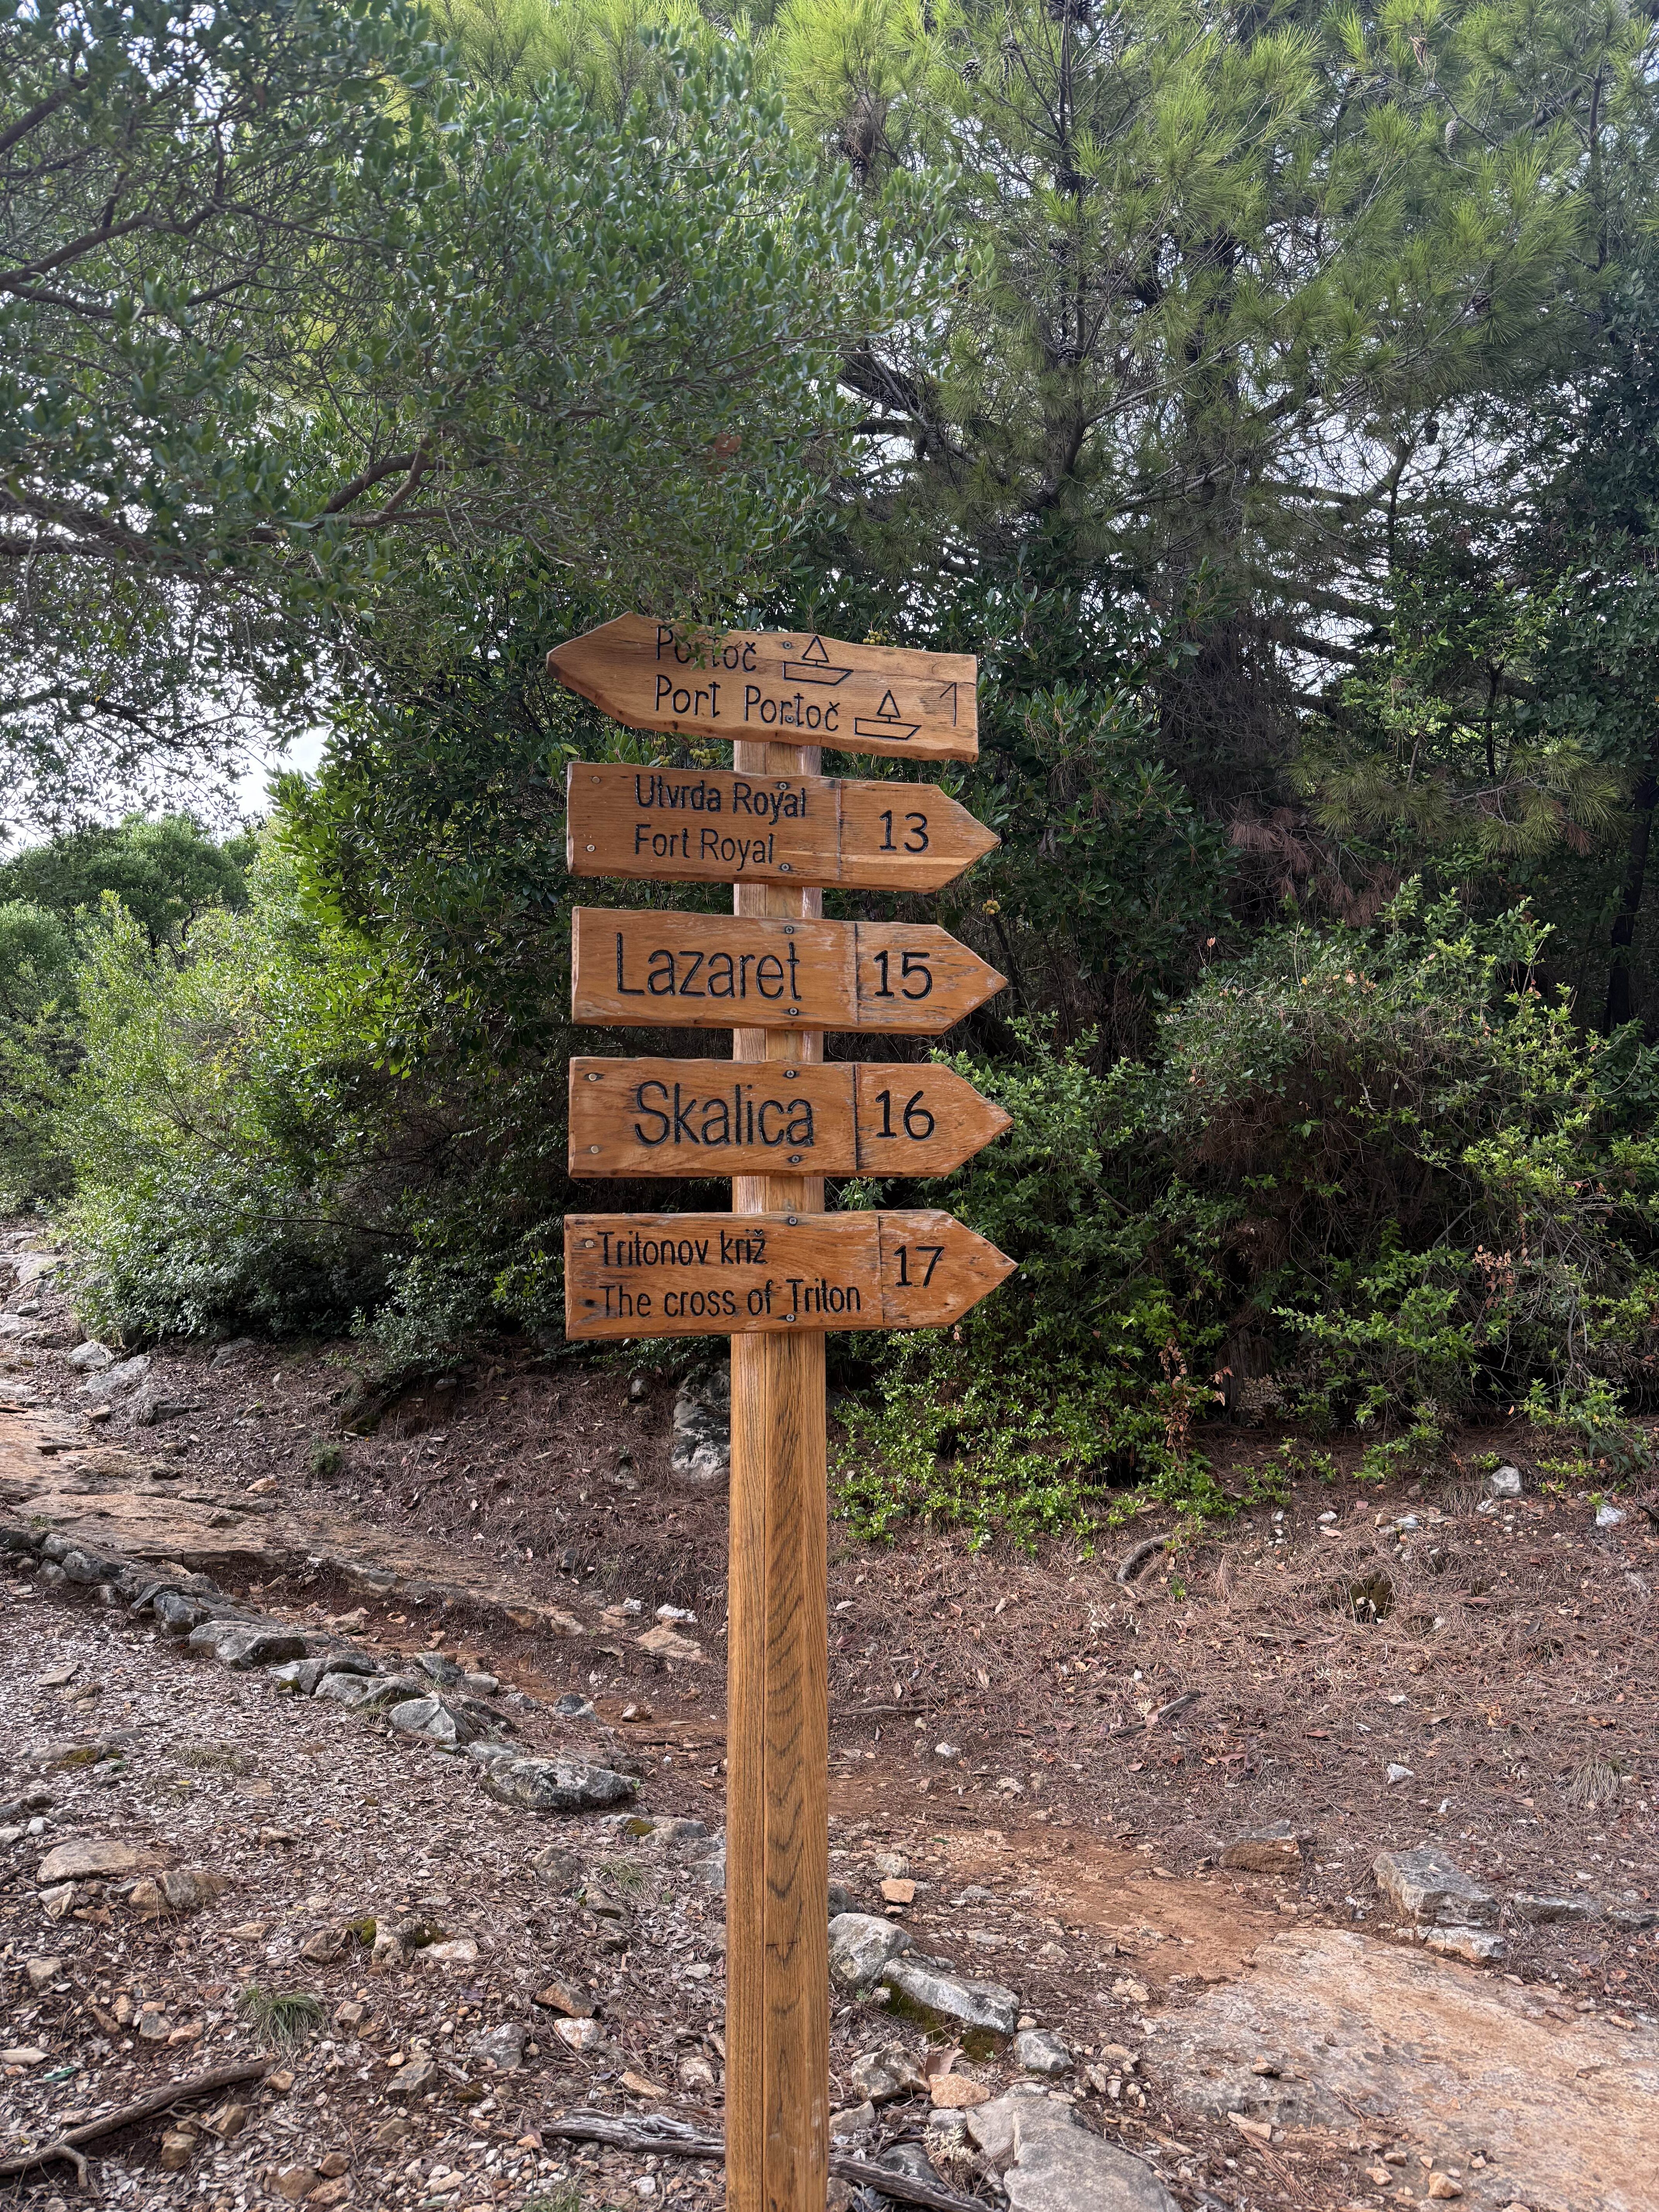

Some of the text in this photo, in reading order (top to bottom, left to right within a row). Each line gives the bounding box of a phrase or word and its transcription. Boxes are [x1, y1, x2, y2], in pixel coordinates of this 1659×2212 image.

[655, 624, 757, 673] Potoč
[654, 674, 841, 732] Port Portoč
[939, 682, 958, 727] 1
[634, 774, 806, 825] Utvrda Royal
[634, 823, 774, 871] Fort Royal
[879, 809, 929, 853] 13
[617, 931, 802, 1001] Lazaret
[873, 950, 933, 1001] 15
[634, 1080, 814, 1147] Skalica
[875, 1089, 934, 1140] 16
[598, 1228, 768, 1267] Tritonov križ
[894, 1245, 945, 1288] 17
[599, 1278, 860, 1317] The cross of Triton
